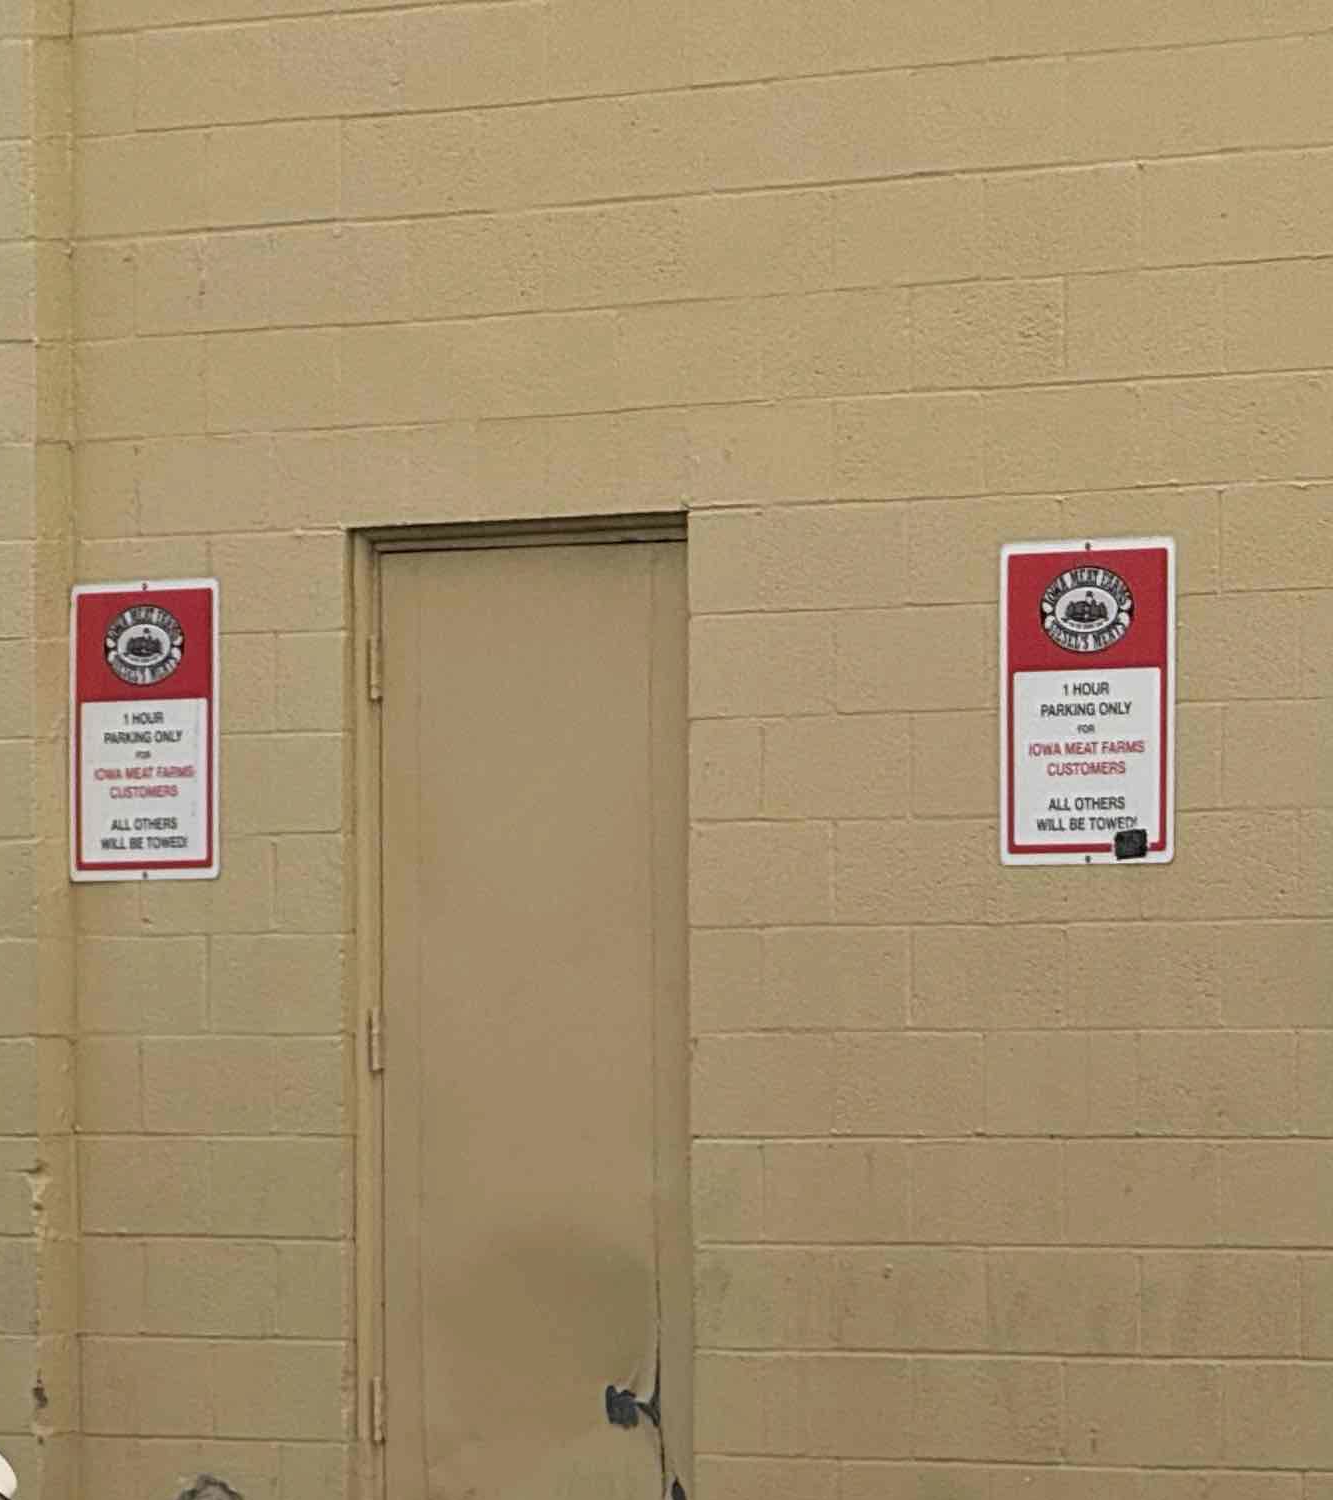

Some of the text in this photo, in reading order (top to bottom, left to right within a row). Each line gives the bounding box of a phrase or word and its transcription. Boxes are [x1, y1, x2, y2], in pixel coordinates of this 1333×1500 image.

[1062, 682, 1109, 696] 1 HOUR
[1040, 702, 1132, 718] PARKING ONLY
[123, 712, 164, 725] 1 HOUR
[1077, 724, 1095, 734] FOR
[104, 730, 183, 744] PARKING ONLY
[1029, 740, 1145, 756] IOWA MEAT FARMS
[94, 765, 194, 781] IOWA MEAT FARMS
[1047, 761, 1126, 776] CUSTOMERS
[109, 785, 179, 799] CUSTOMERS
[1048, 796, 1125, 812] ALL OTHERS
[110, 817, 178, 831] ALL OTHERS
[1037, 818, 1065, 832] WILL
[1070, 817, 1085, 830] BE
[101, 837, 127, 850] WILL
[129, 836, 144, 849] BE
